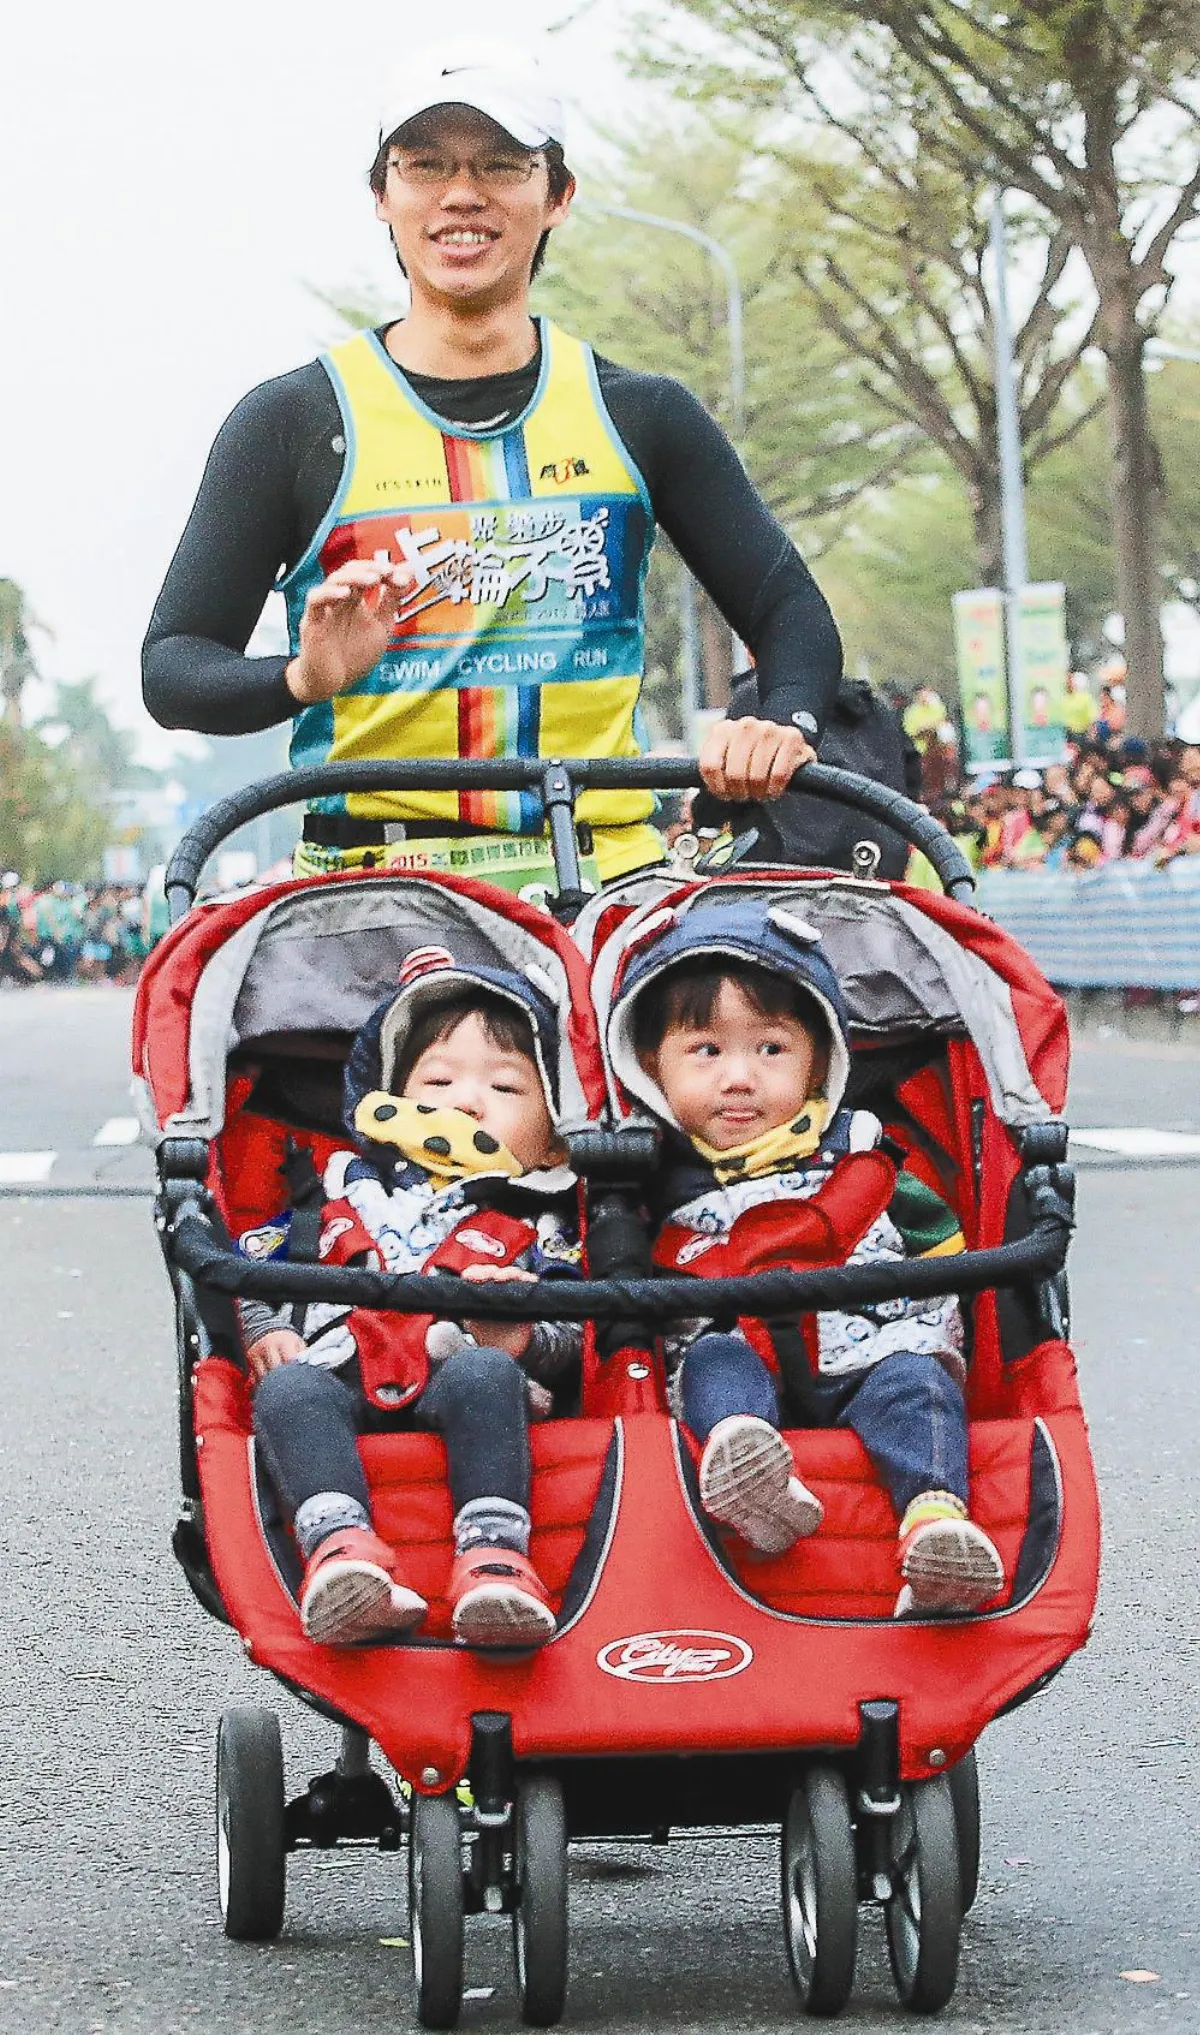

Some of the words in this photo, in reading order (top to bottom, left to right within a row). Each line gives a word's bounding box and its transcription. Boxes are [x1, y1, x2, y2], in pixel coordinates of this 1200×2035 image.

[379, 660, 440, 682] SWIM
[459, 652, 557, 674] CYCLING
[573, 649, 608, 667] RUN
[391, 852, 428, 869] 2015
